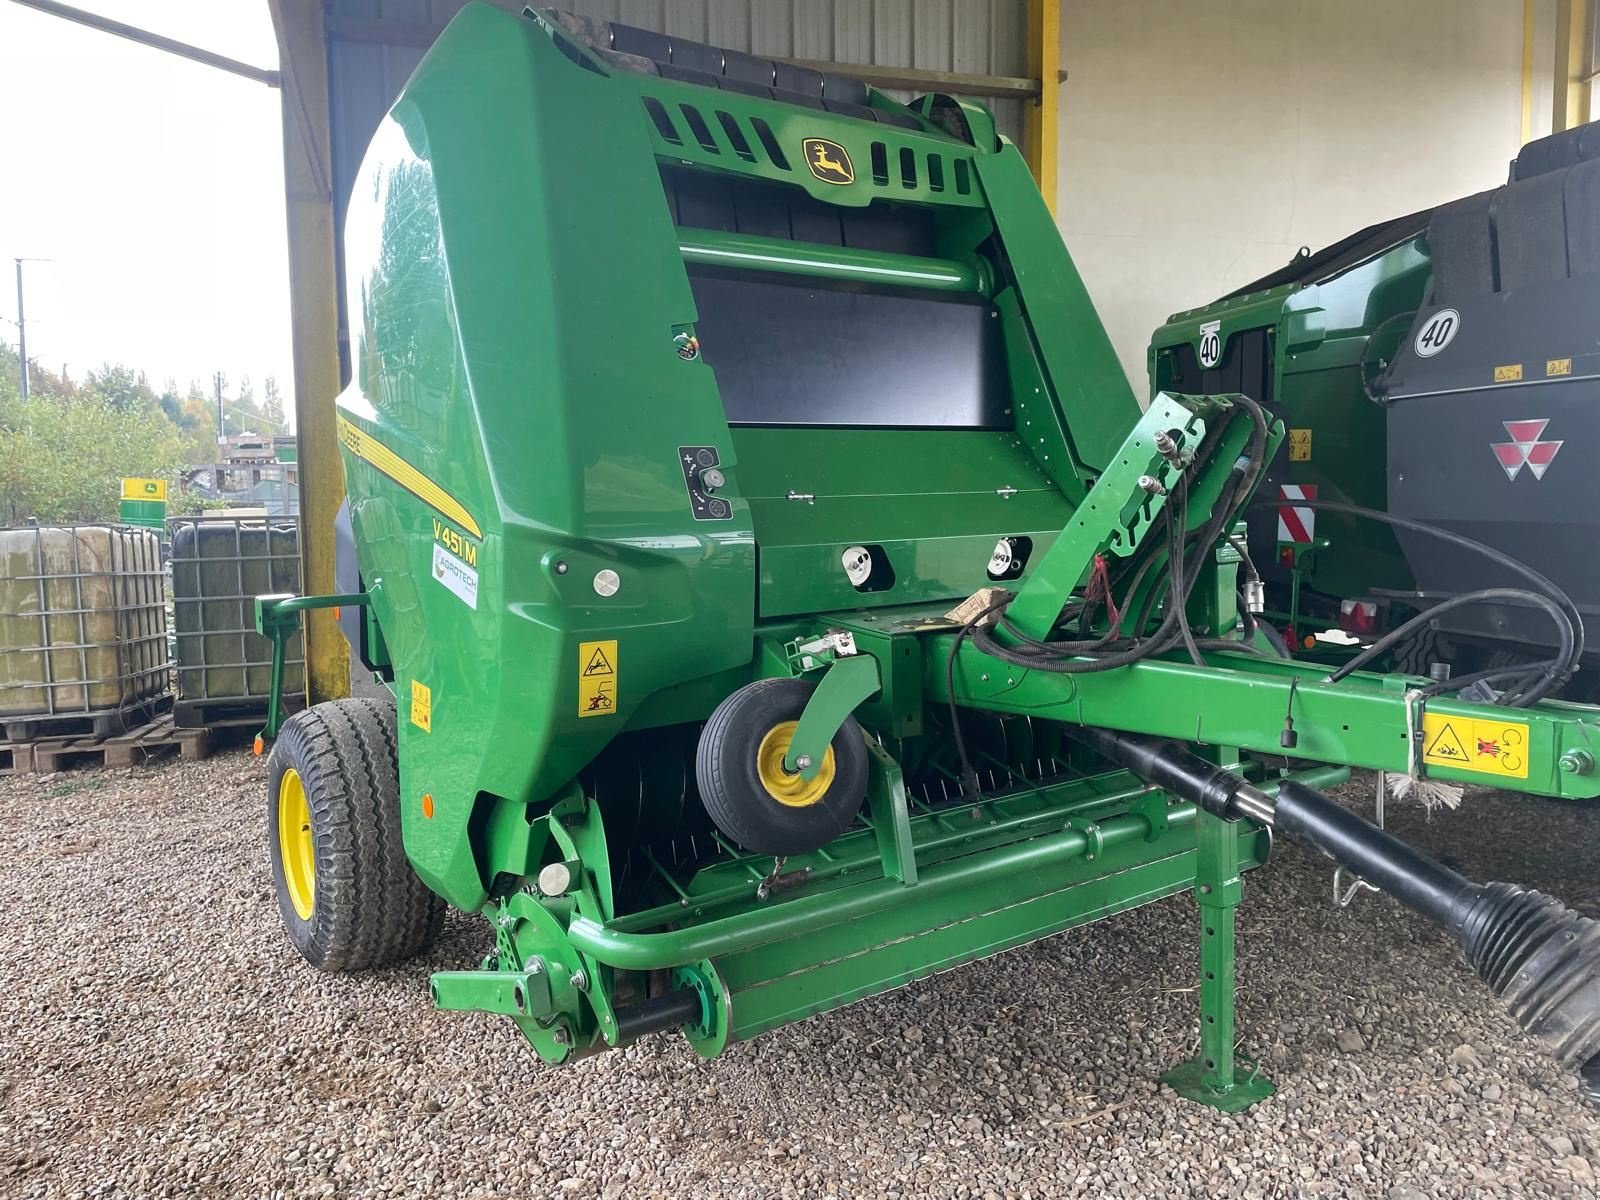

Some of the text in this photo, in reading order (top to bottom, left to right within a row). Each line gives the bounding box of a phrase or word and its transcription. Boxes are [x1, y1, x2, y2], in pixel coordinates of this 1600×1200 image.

[1201, 335, 1219, 363] 40
[1421, 317, 1454, 348] 40
[432, 516, 477, 569] V 451 M
[440, 556, 477, 591] AGROTECH
